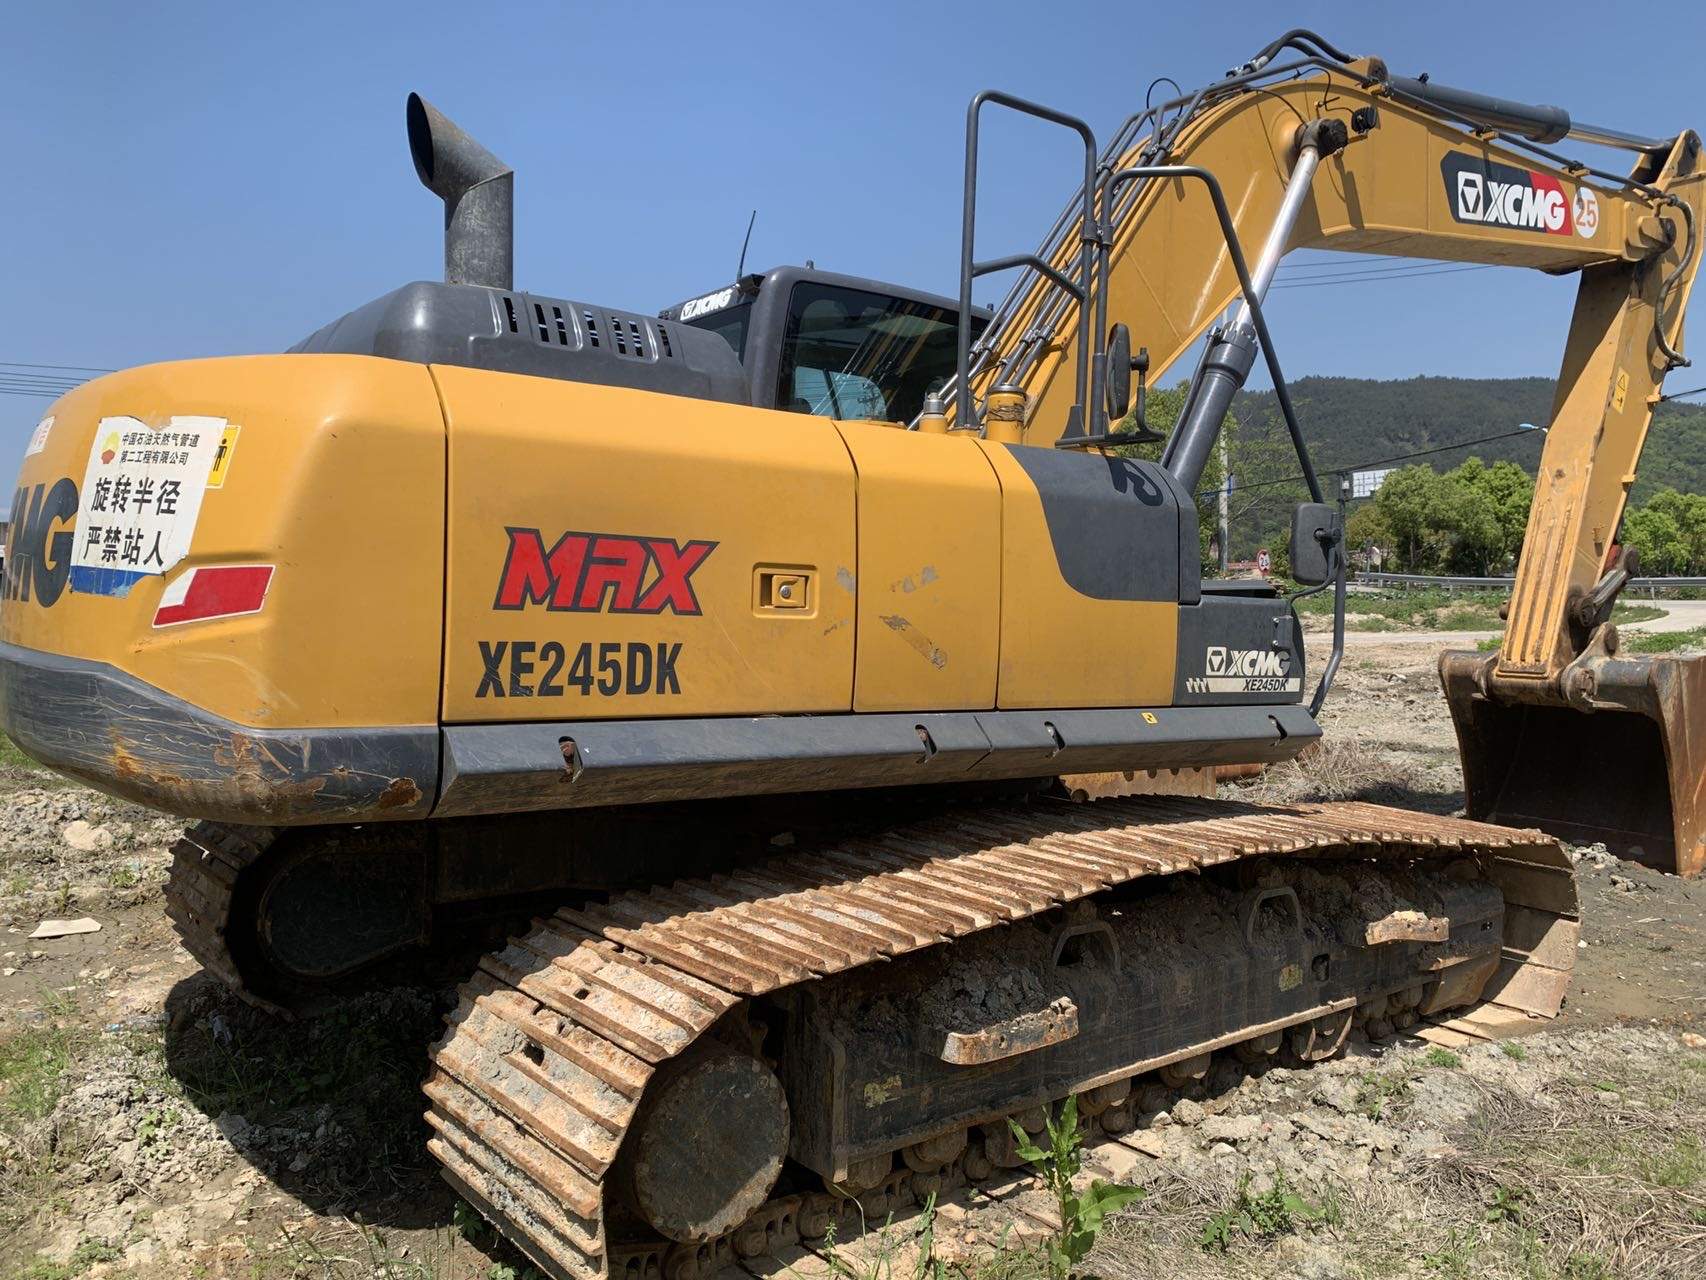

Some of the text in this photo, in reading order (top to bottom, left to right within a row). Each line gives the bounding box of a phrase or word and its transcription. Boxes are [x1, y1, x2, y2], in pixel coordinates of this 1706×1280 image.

[1483, 181, 1565, 231] XCMG
[1576, 200, 1597, 228] 25
[122, 432, 200, 448] 中国石油天然气管道
[119, 450, 189, 466] 第二工程有限公司
[90, 474, 181, 516] 旋转半径
[83, 526, 164, 567] 严禁站人
[493, 526, 720, 616] MAX
[475, 641, 683, 698] XE245DK
[1225, 650, 1290, 677] XCMG
[1242, 678, 1289, 692] XE245DK
